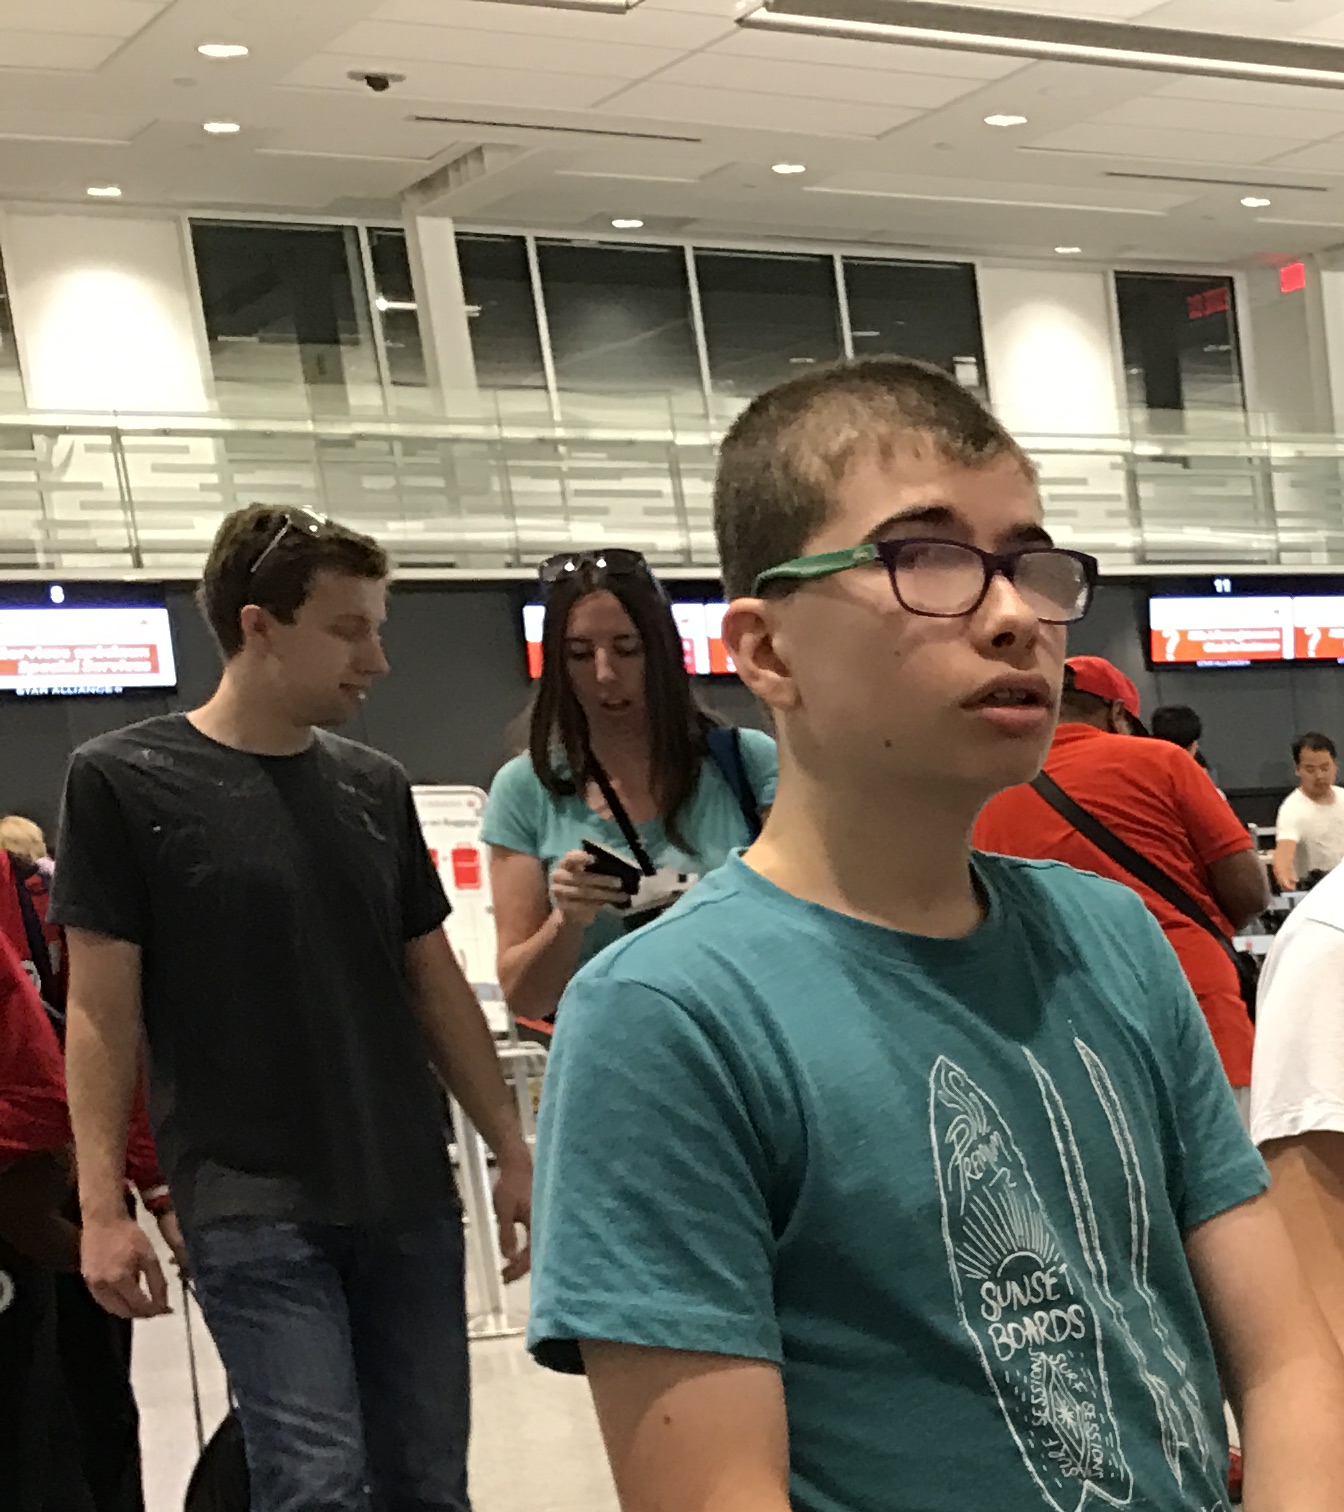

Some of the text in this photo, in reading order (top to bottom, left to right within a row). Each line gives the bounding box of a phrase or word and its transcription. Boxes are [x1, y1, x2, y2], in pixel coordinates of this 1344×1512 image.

[1213, 578, 1231, 593] 11
[980, 1262, 1074, 1321] SUNSET
[987, 1304, 1086, 1361] BOARDS
